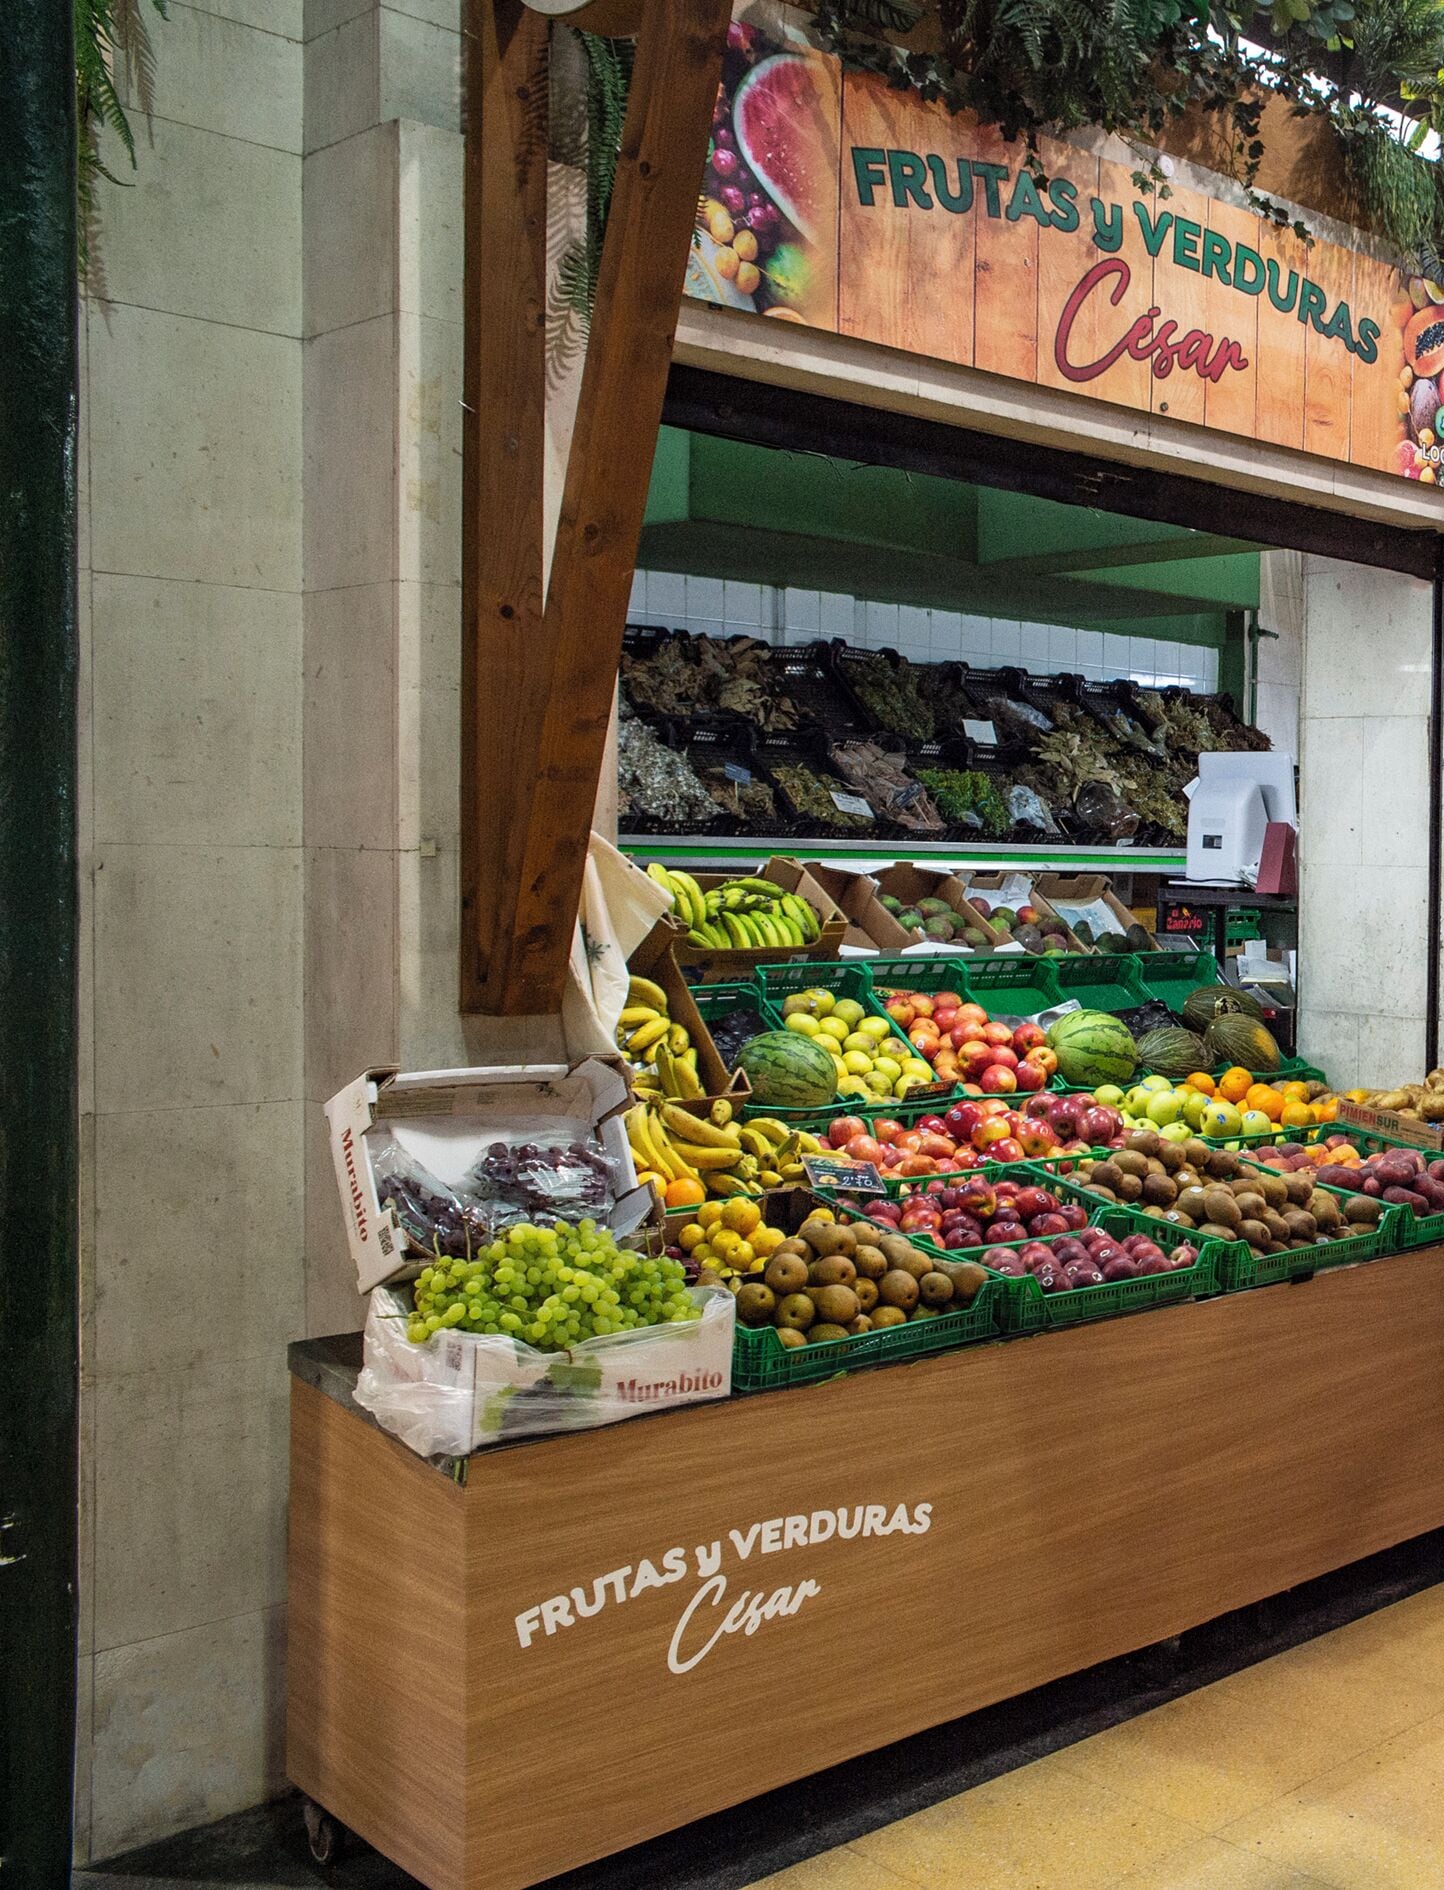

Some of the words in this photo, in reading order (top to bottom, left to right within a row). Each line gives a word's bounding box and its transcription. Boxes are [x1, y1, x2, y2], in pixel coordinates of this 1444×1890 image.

[851, 147, 1080, 233] FRUTAS
[1091, 197, 1123, 252] y
[1133, 201, 1380, 363] VERDURAS
[1055, 257, 1248, 382] César
[1340, 1103, 1399, 1131] PIMIENSUR
[341, 1127, 368, 1242] Murabito
[616, 1367, 723, 1403] Murabito
[514, 1547, 686, 1648] FRUTAS
[695, 1541, 721, 1577] y
[729, 1503, 932, 1560] VERDURAS
